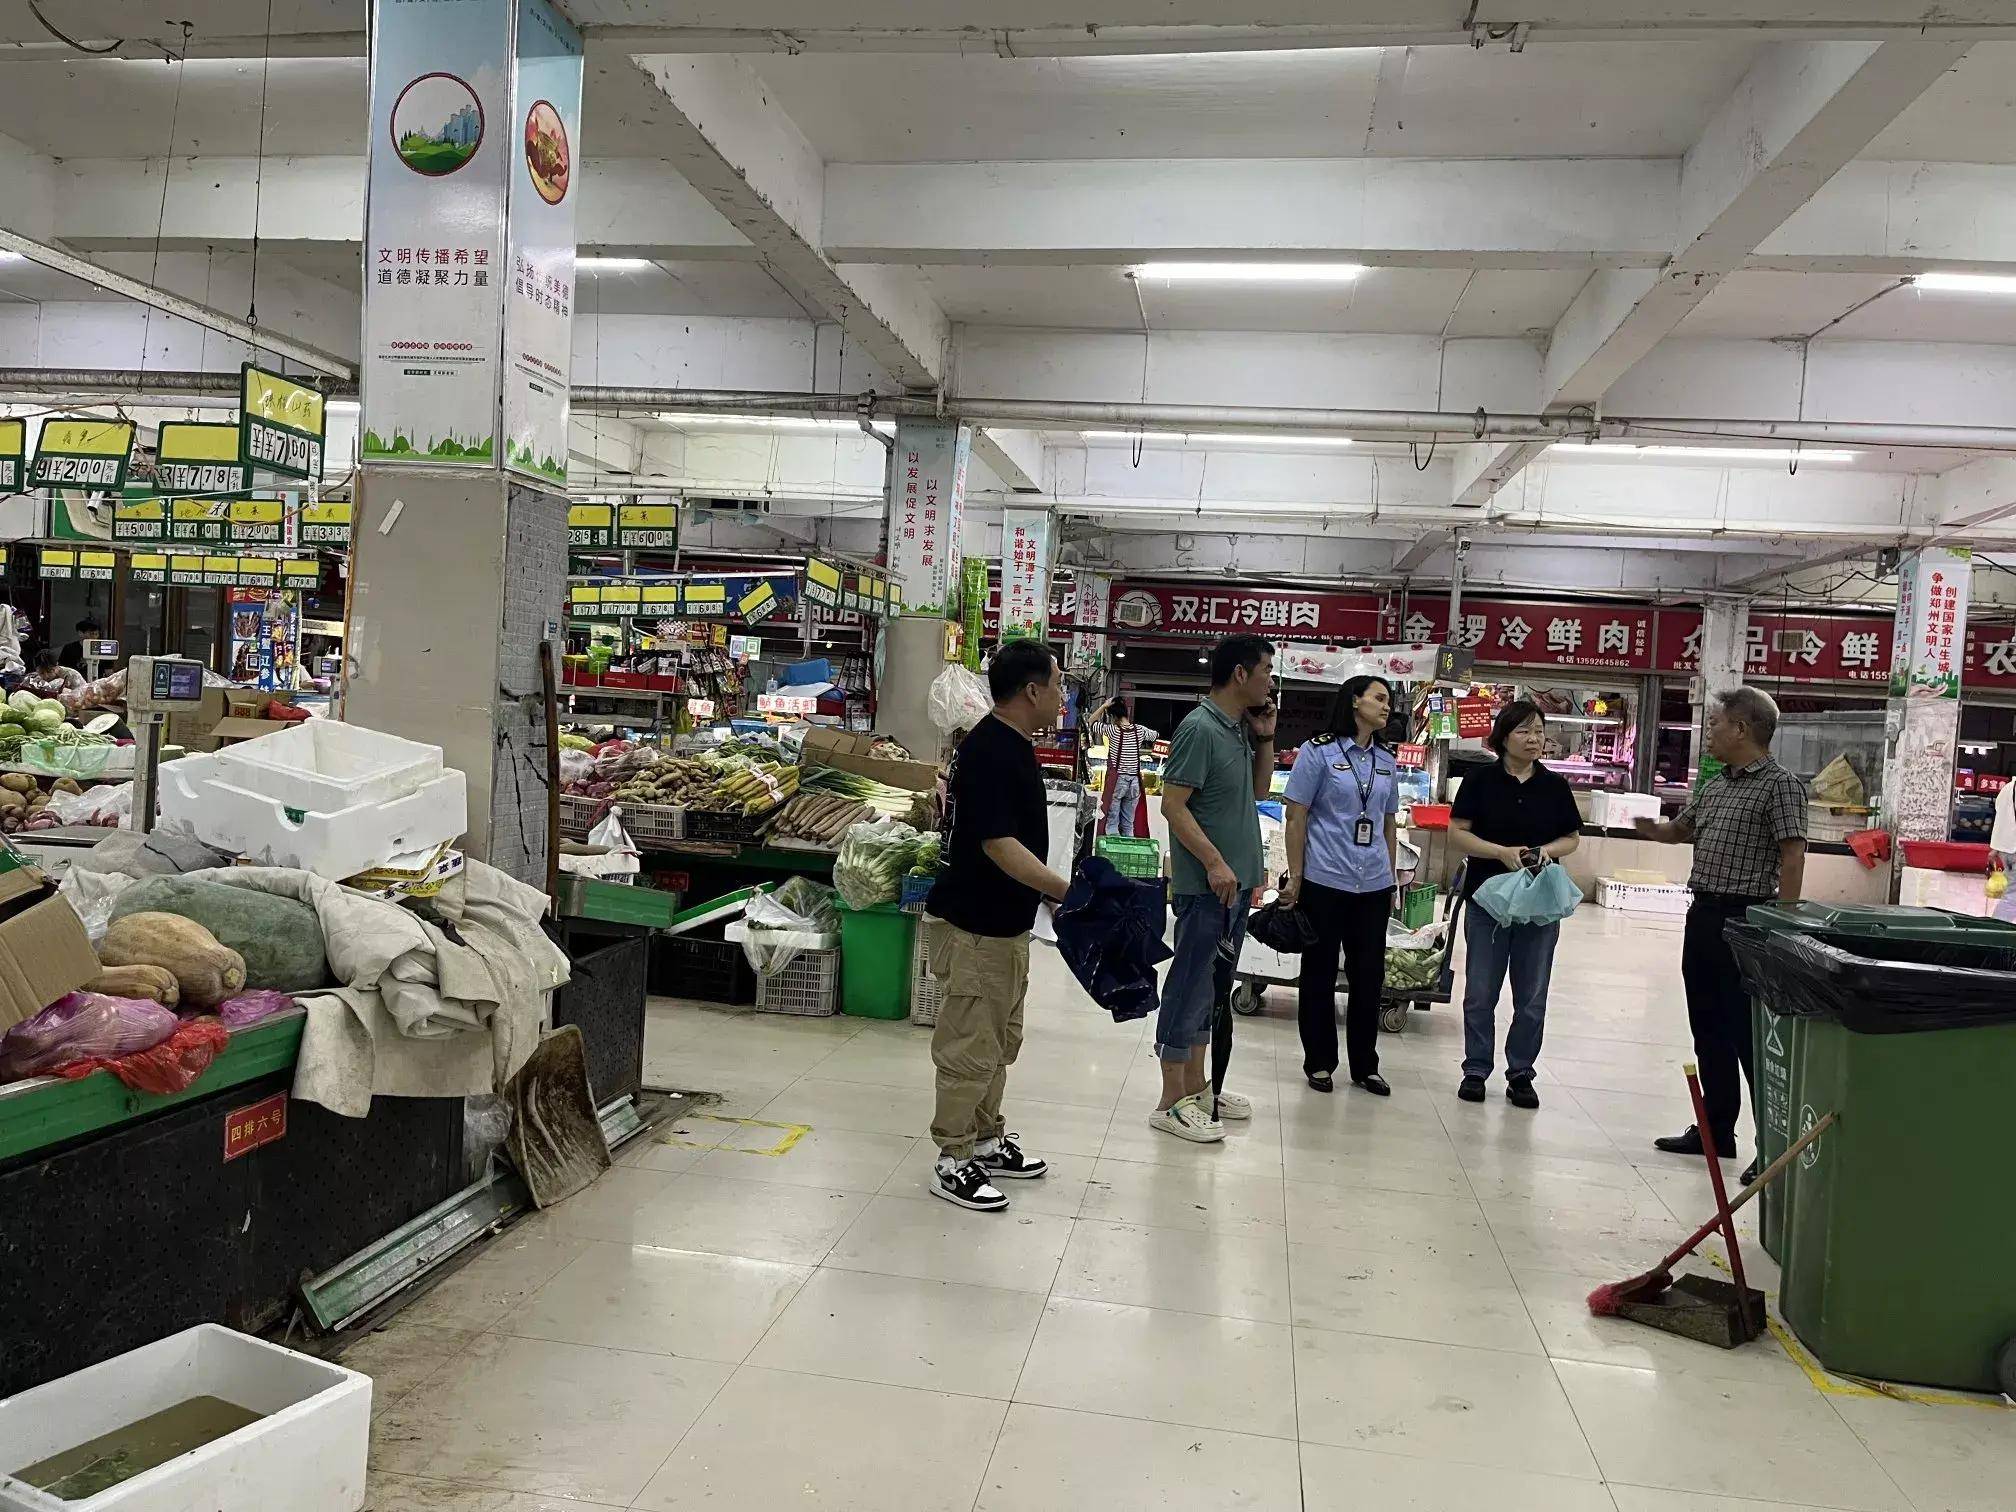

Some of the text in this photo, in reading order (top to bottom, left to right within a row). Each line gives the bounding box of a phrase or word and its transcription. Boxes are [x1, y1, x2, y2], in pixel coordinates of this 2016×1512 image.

[377, 268, 489, 287] 道德凝聚力量
[379, 248, 489, 265] 文明传播希望
[516, 255, 569, 300] 弘扬统美德
[904, 451, 919, 540] 以发展促文明
[922, 479, 938, 567] 以文明求发展
[1011, 527, 1025, 617] 和谐始于一言一行
[1023, 539, 1036, 629] 文明源于一点一滴
[1170, 595, 1321, 629] 双汇冷鲜肉
[1403, 611, 1630, 656] 金锣冷鲜肉
[1924, 571, 1943, 660] 争做郑州文明人
[1937, 586, 1957, 674] 创建国家卫生城
[1556, 655, 1575, 666] 电话
[231, 1108, 282, 1142] 四排六号
